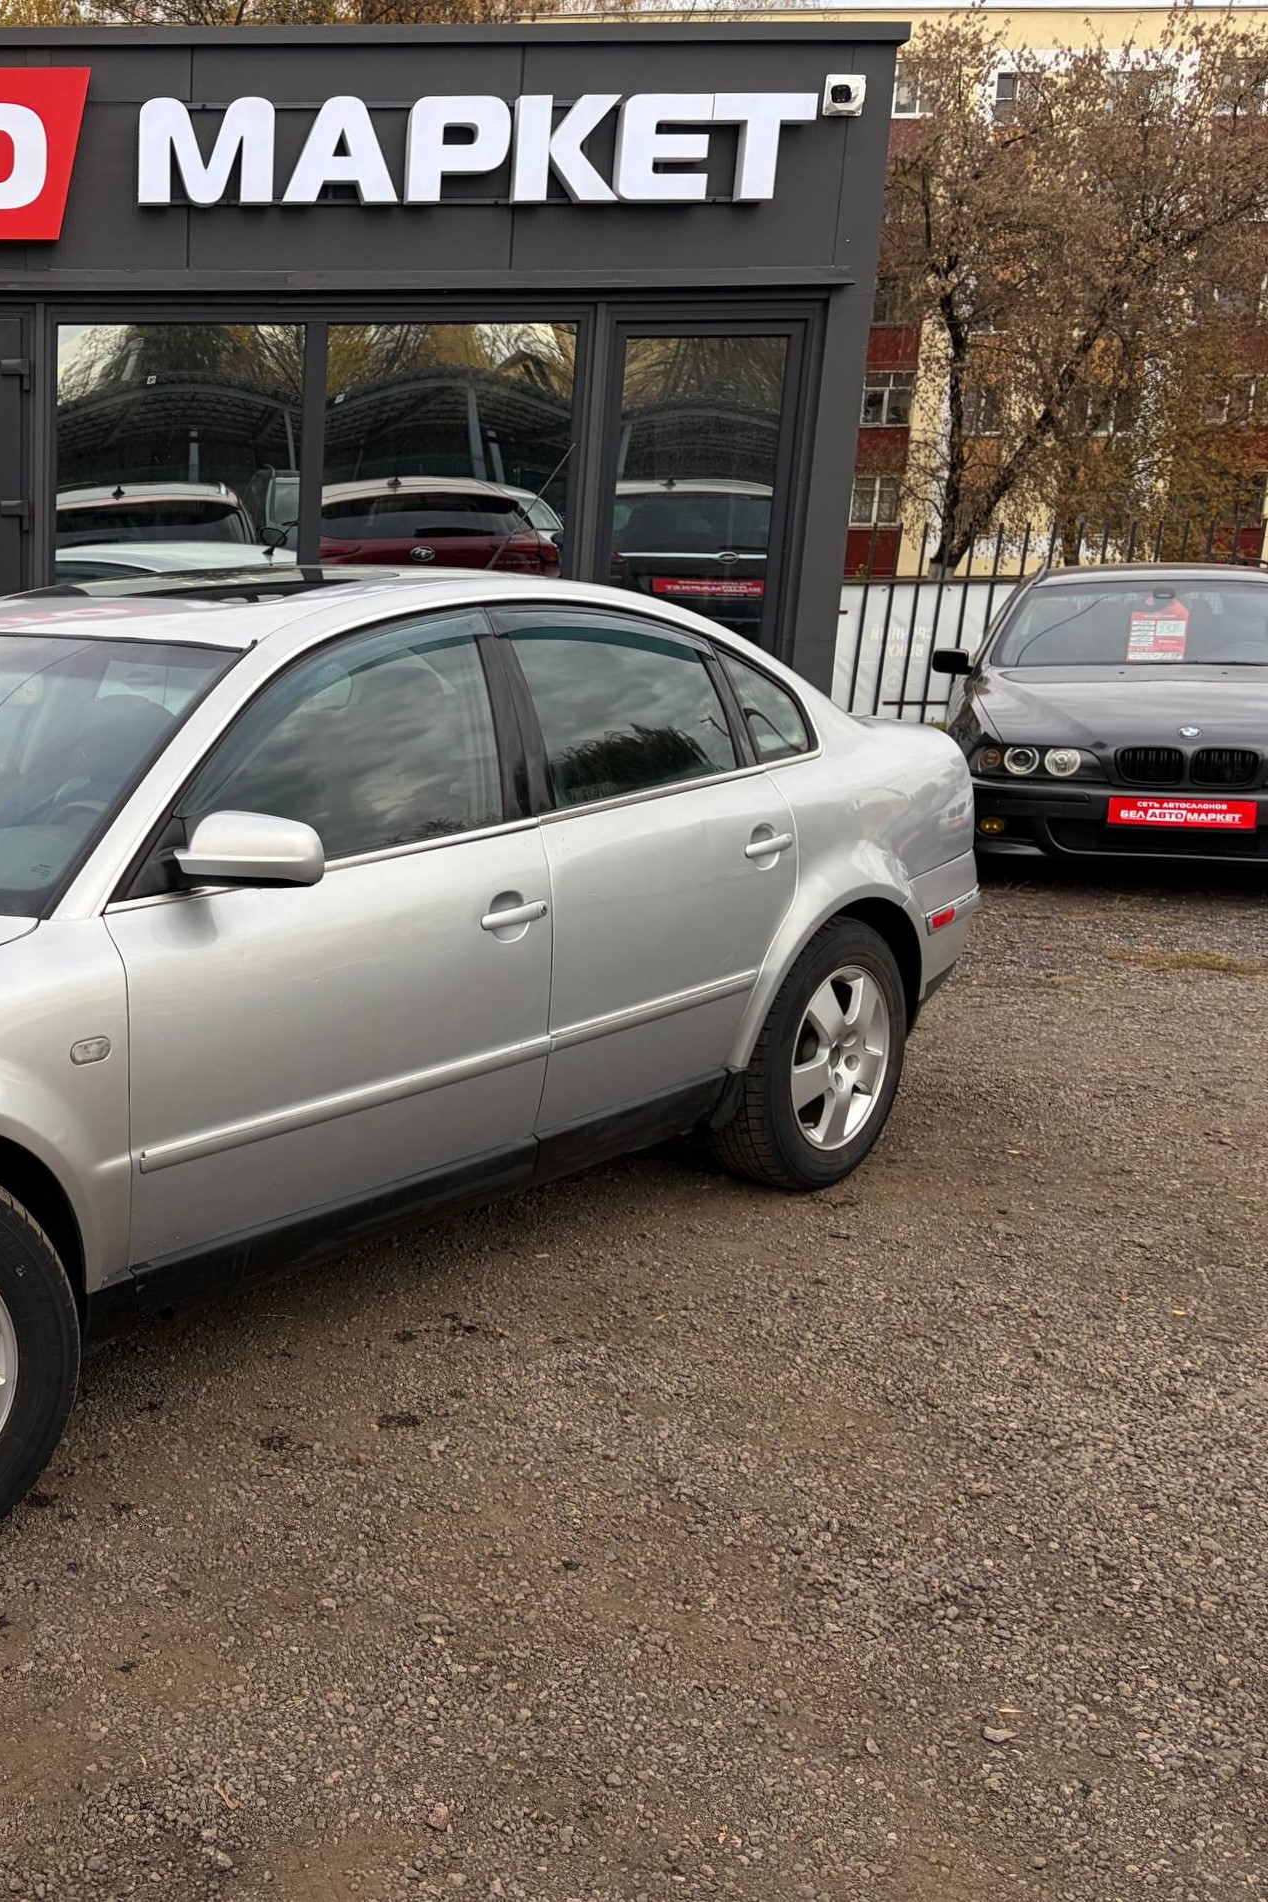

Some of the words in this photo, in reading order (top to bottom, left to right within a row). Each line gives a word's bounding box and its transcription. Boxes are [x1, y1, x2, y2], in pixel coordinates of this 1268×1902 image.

[138, 92, 819, 208] МАРКЕТ
[1120, 810, 1145, 819] БЕЛ
[1150, 811, 1183, 820] АВТО
[1186, 813, 1242, 822] МАРКЕТ
